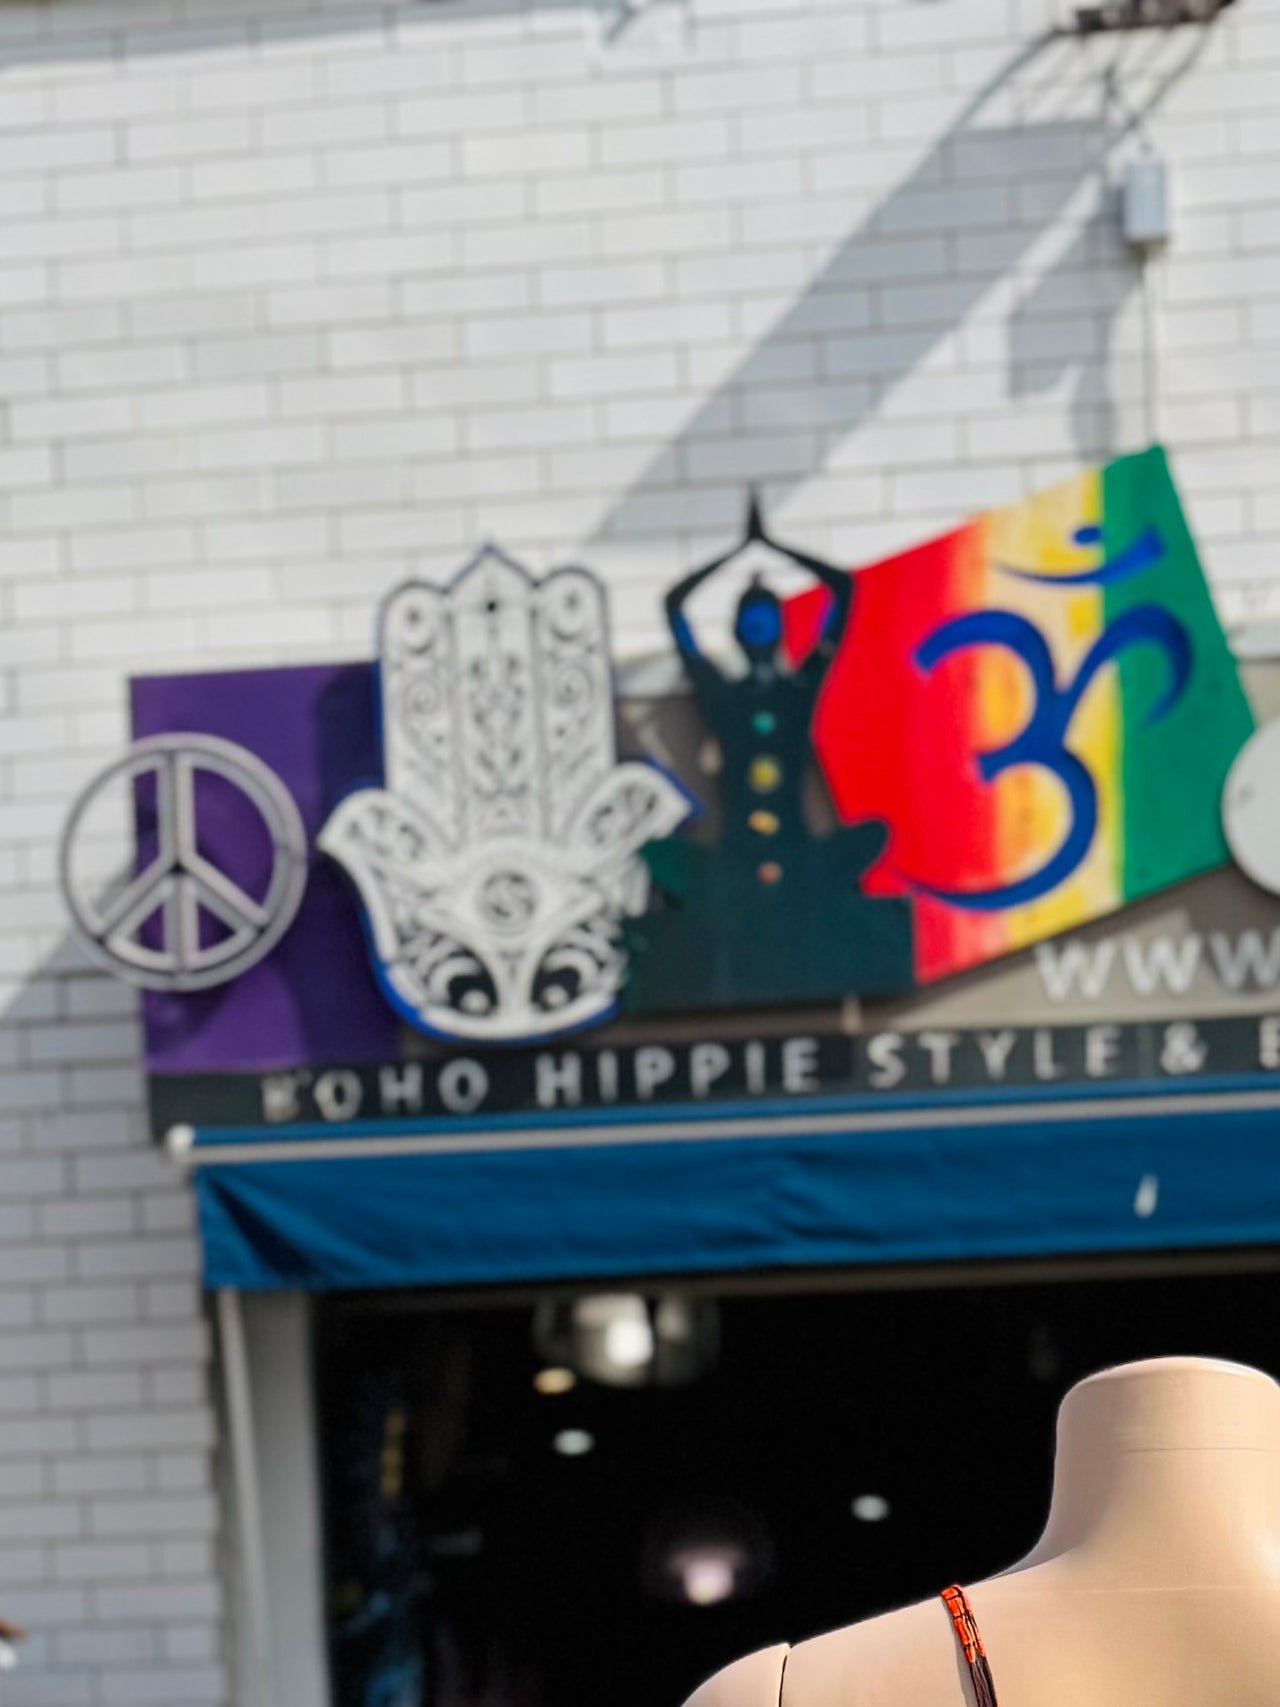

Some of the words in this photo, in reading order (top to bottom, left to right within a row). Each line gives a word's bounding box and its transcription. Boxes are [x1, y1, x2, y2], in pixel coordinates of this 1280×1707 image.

[261, 1057, 489, 1122] BOHO
[535, 1038, 820, 1108] HIPPIE
[868, 1024, 1120, 1089] STYLE
[1159, 1021, 1205, 1071] &
